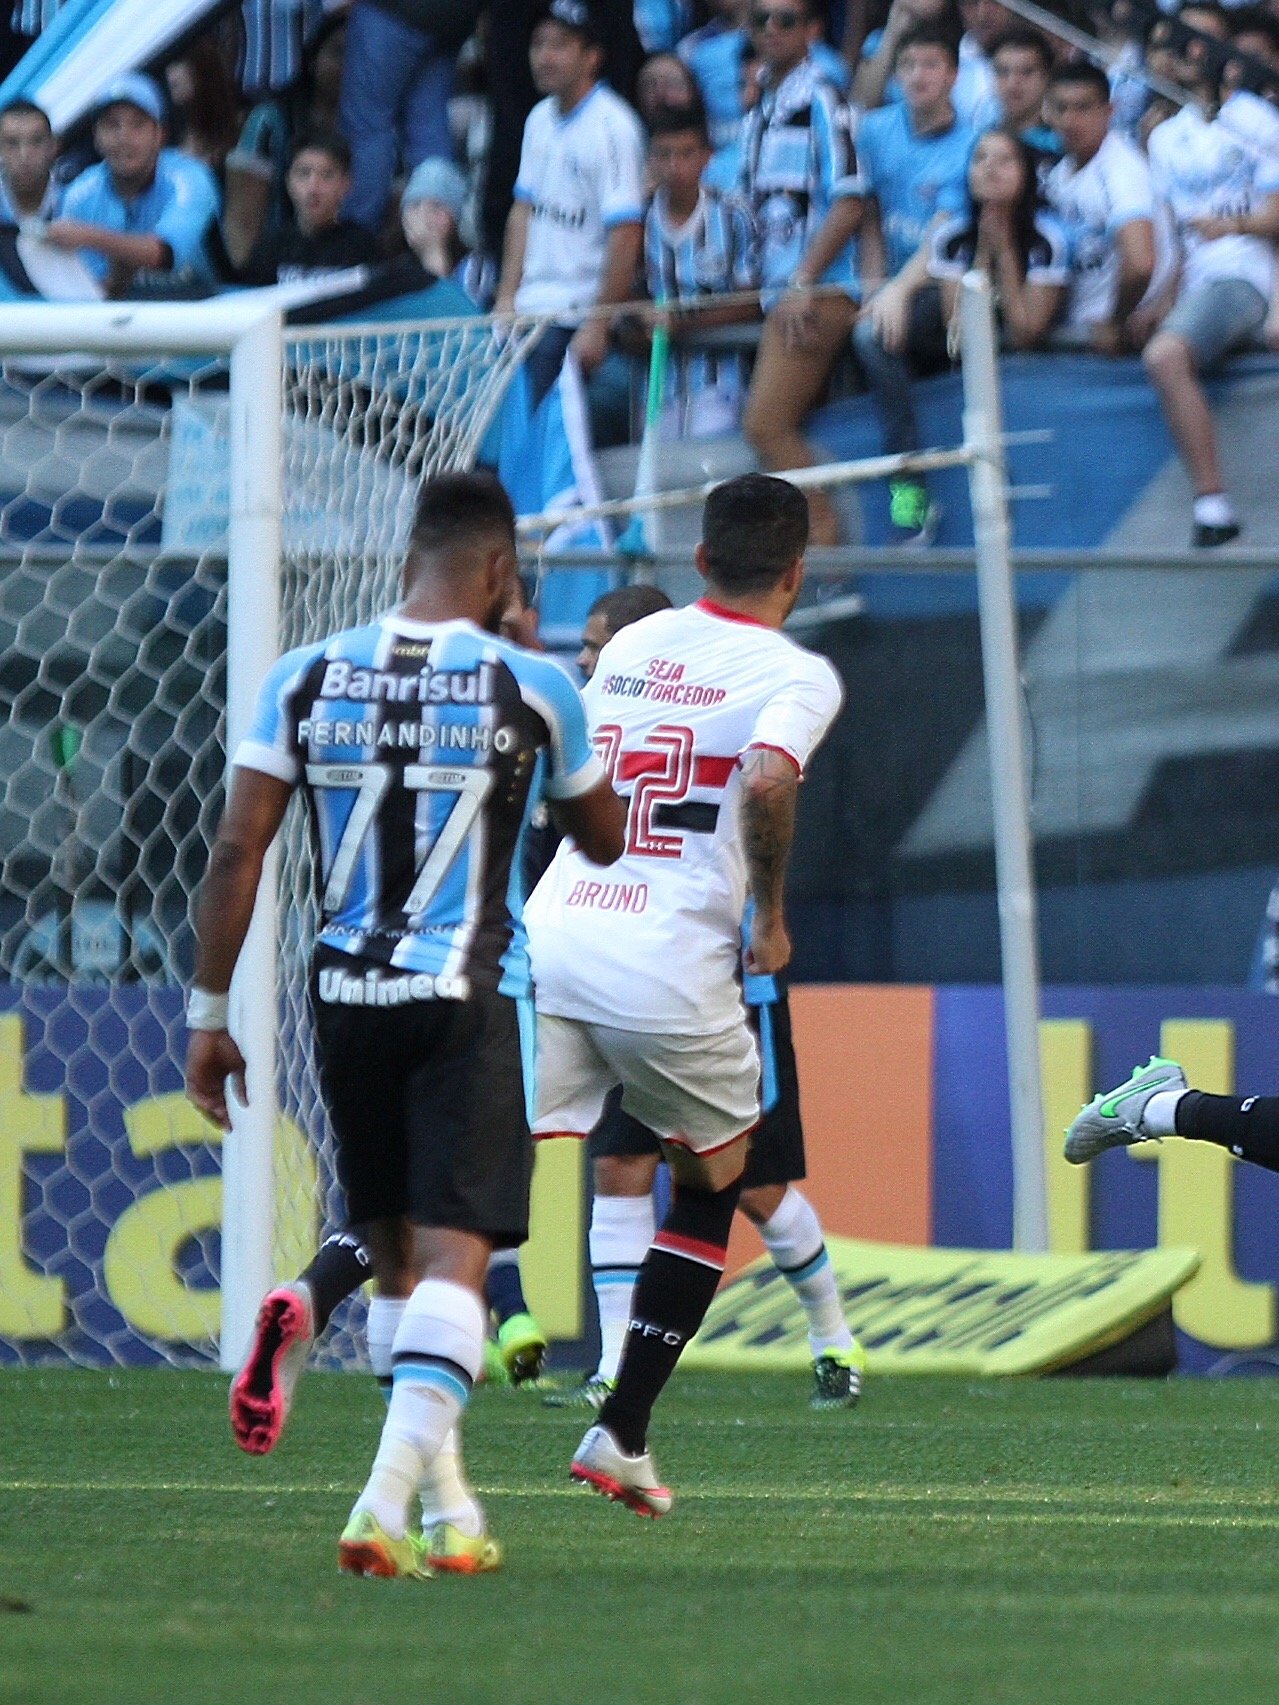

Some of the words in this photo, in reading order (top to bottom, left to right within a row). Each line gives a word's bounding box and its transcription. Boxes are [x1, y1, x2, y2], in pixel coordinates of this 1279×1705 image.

[320, 660, 491, 703] Banrisul
[646, 658, 685, 681] SEJA
[601, 673, 727, 707] #SOCIOTORCEDOR
[298, 720, 511, 753] FERNANDINHO
[305, 763, 492, 914] 77
[567, 880, 649, 914] BRUNO
